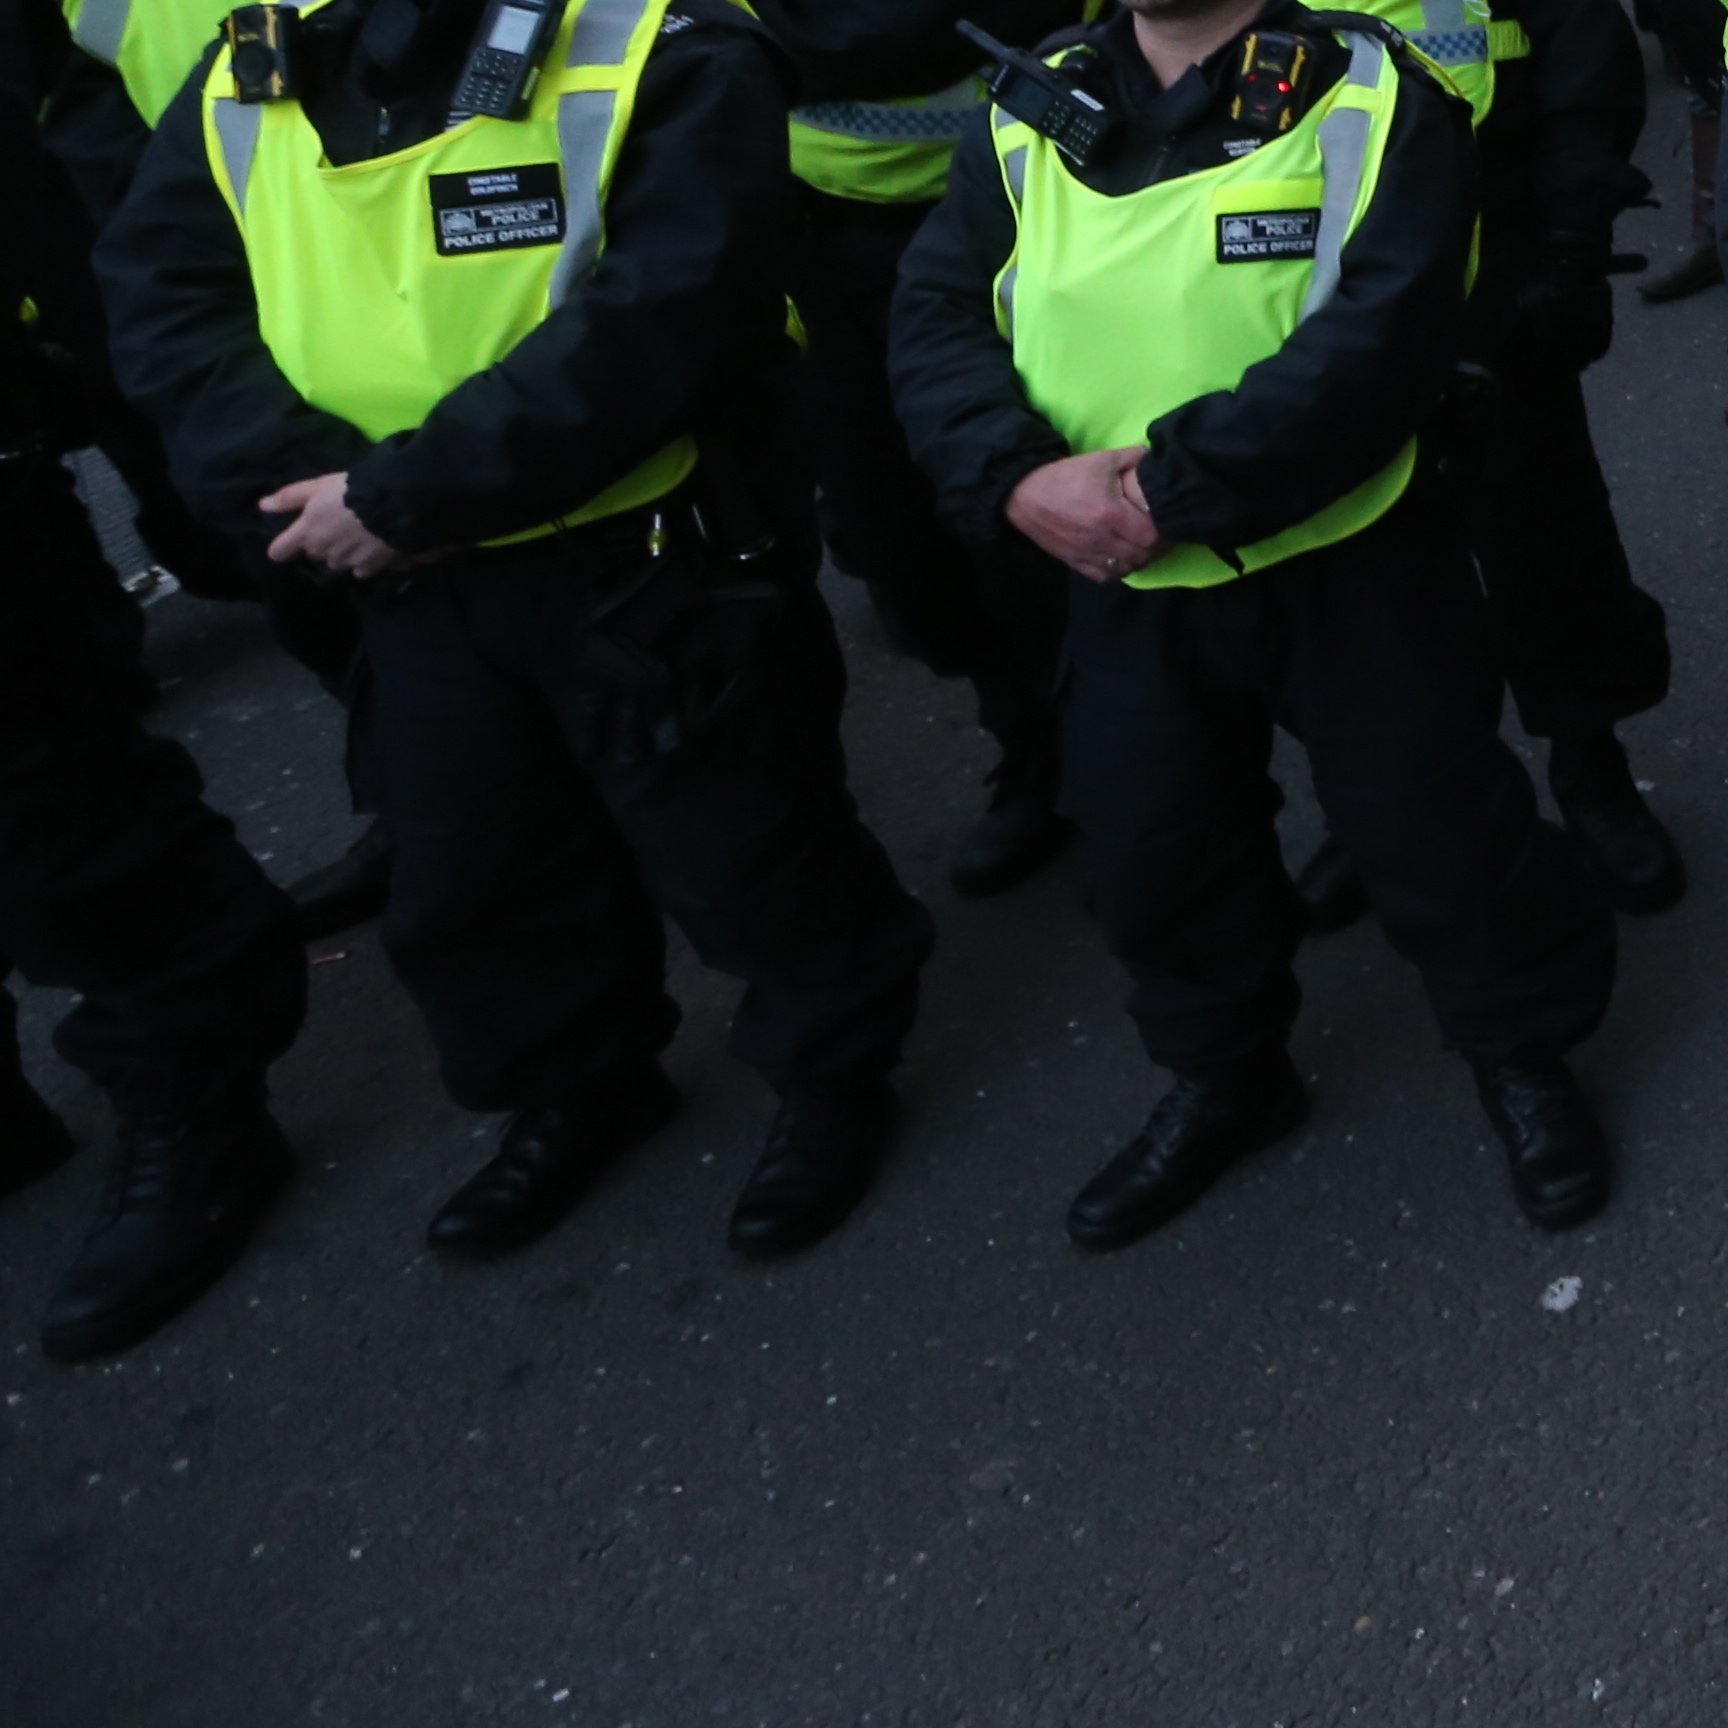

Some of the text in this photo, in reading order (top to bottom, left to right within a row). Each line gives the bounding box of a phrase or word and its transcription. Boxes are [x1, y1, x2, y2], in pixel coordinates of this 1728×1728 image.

[491, 210, 540, 226] POLICE
[443, 223, 559, 249] POLICE OFFICER
[1265, 222, 1304, 236] POLICE
[1223, 238, 1314, 255] POLICE OFFICER
